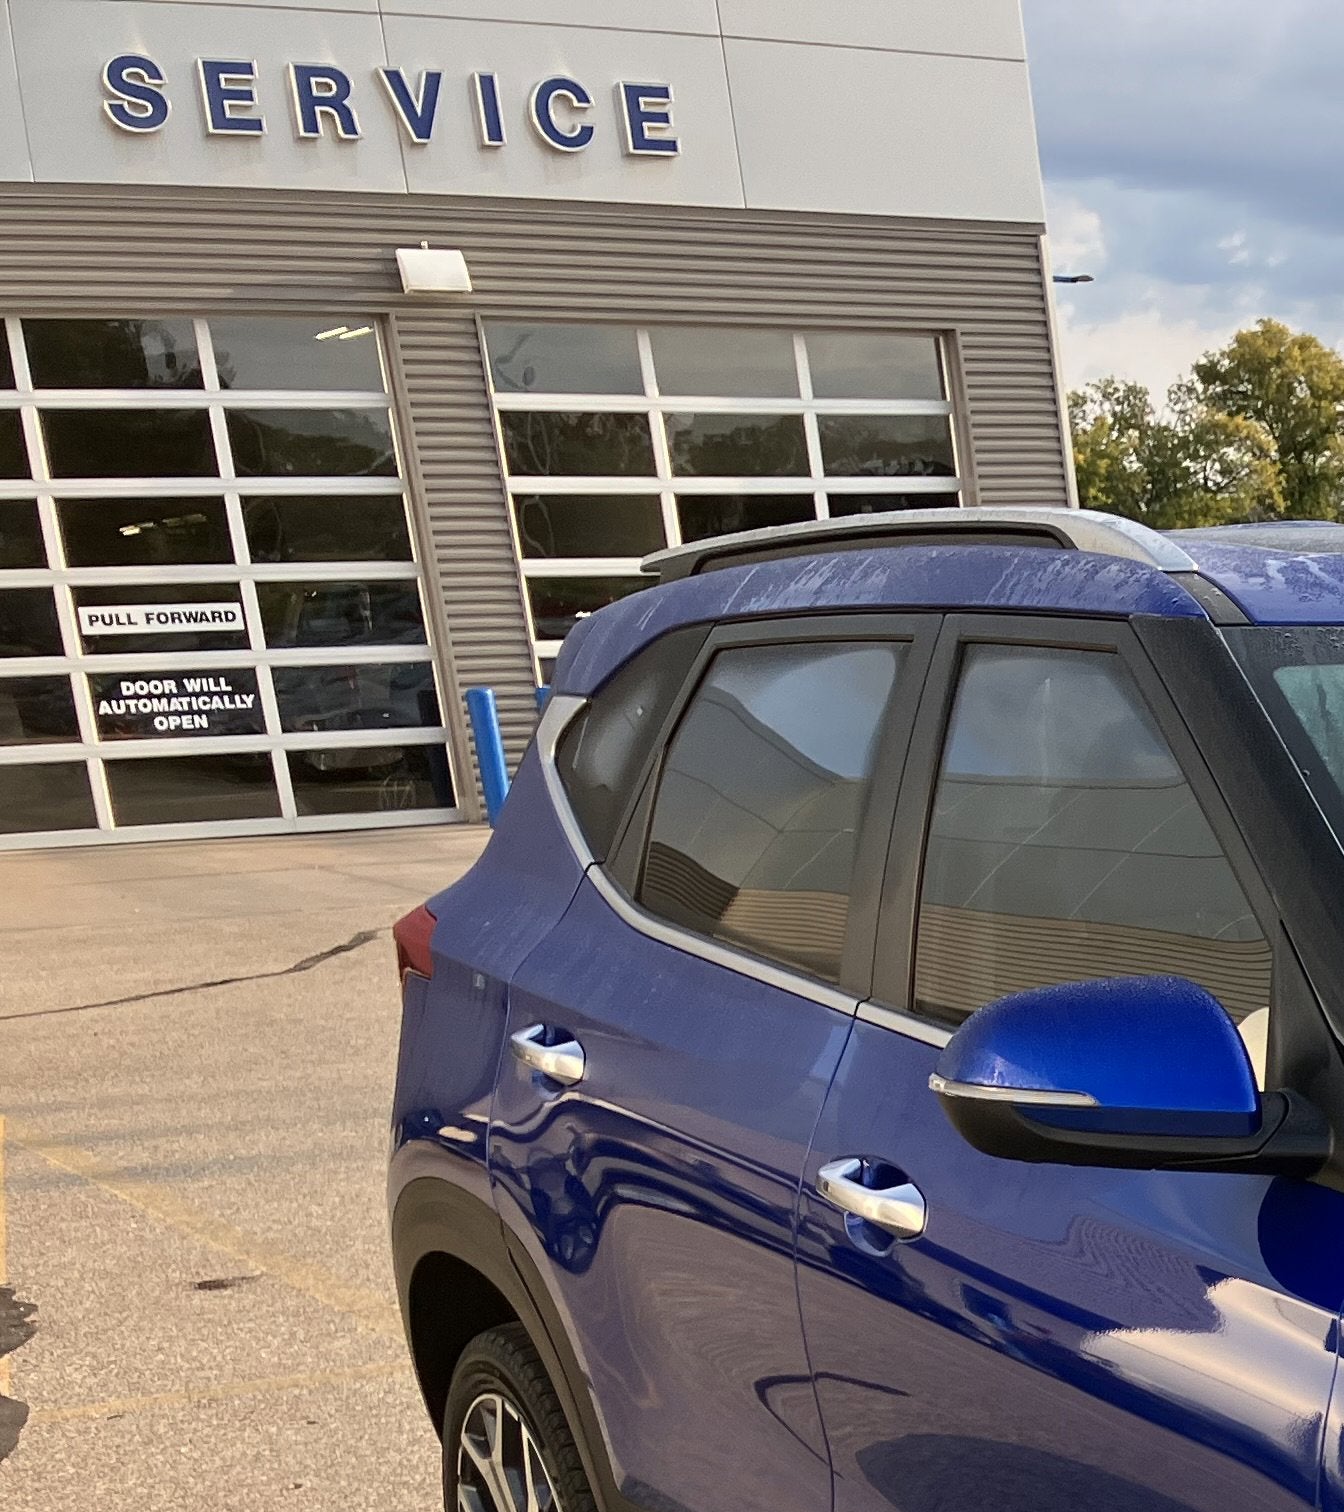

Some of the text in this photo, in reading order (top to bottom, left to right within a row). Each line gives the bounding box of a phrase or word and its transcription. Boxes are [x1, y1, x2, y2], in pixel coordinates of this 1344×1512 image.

[102, 53, 682, 158] SERVICE
[88, 610, 237, 627] PULL FORWARD
[120, 677, 232, 696] DOOR WILL
[99, 694, 255, 716] AUTOMATICALLY
[154, 713, 209, 731] OPEN
